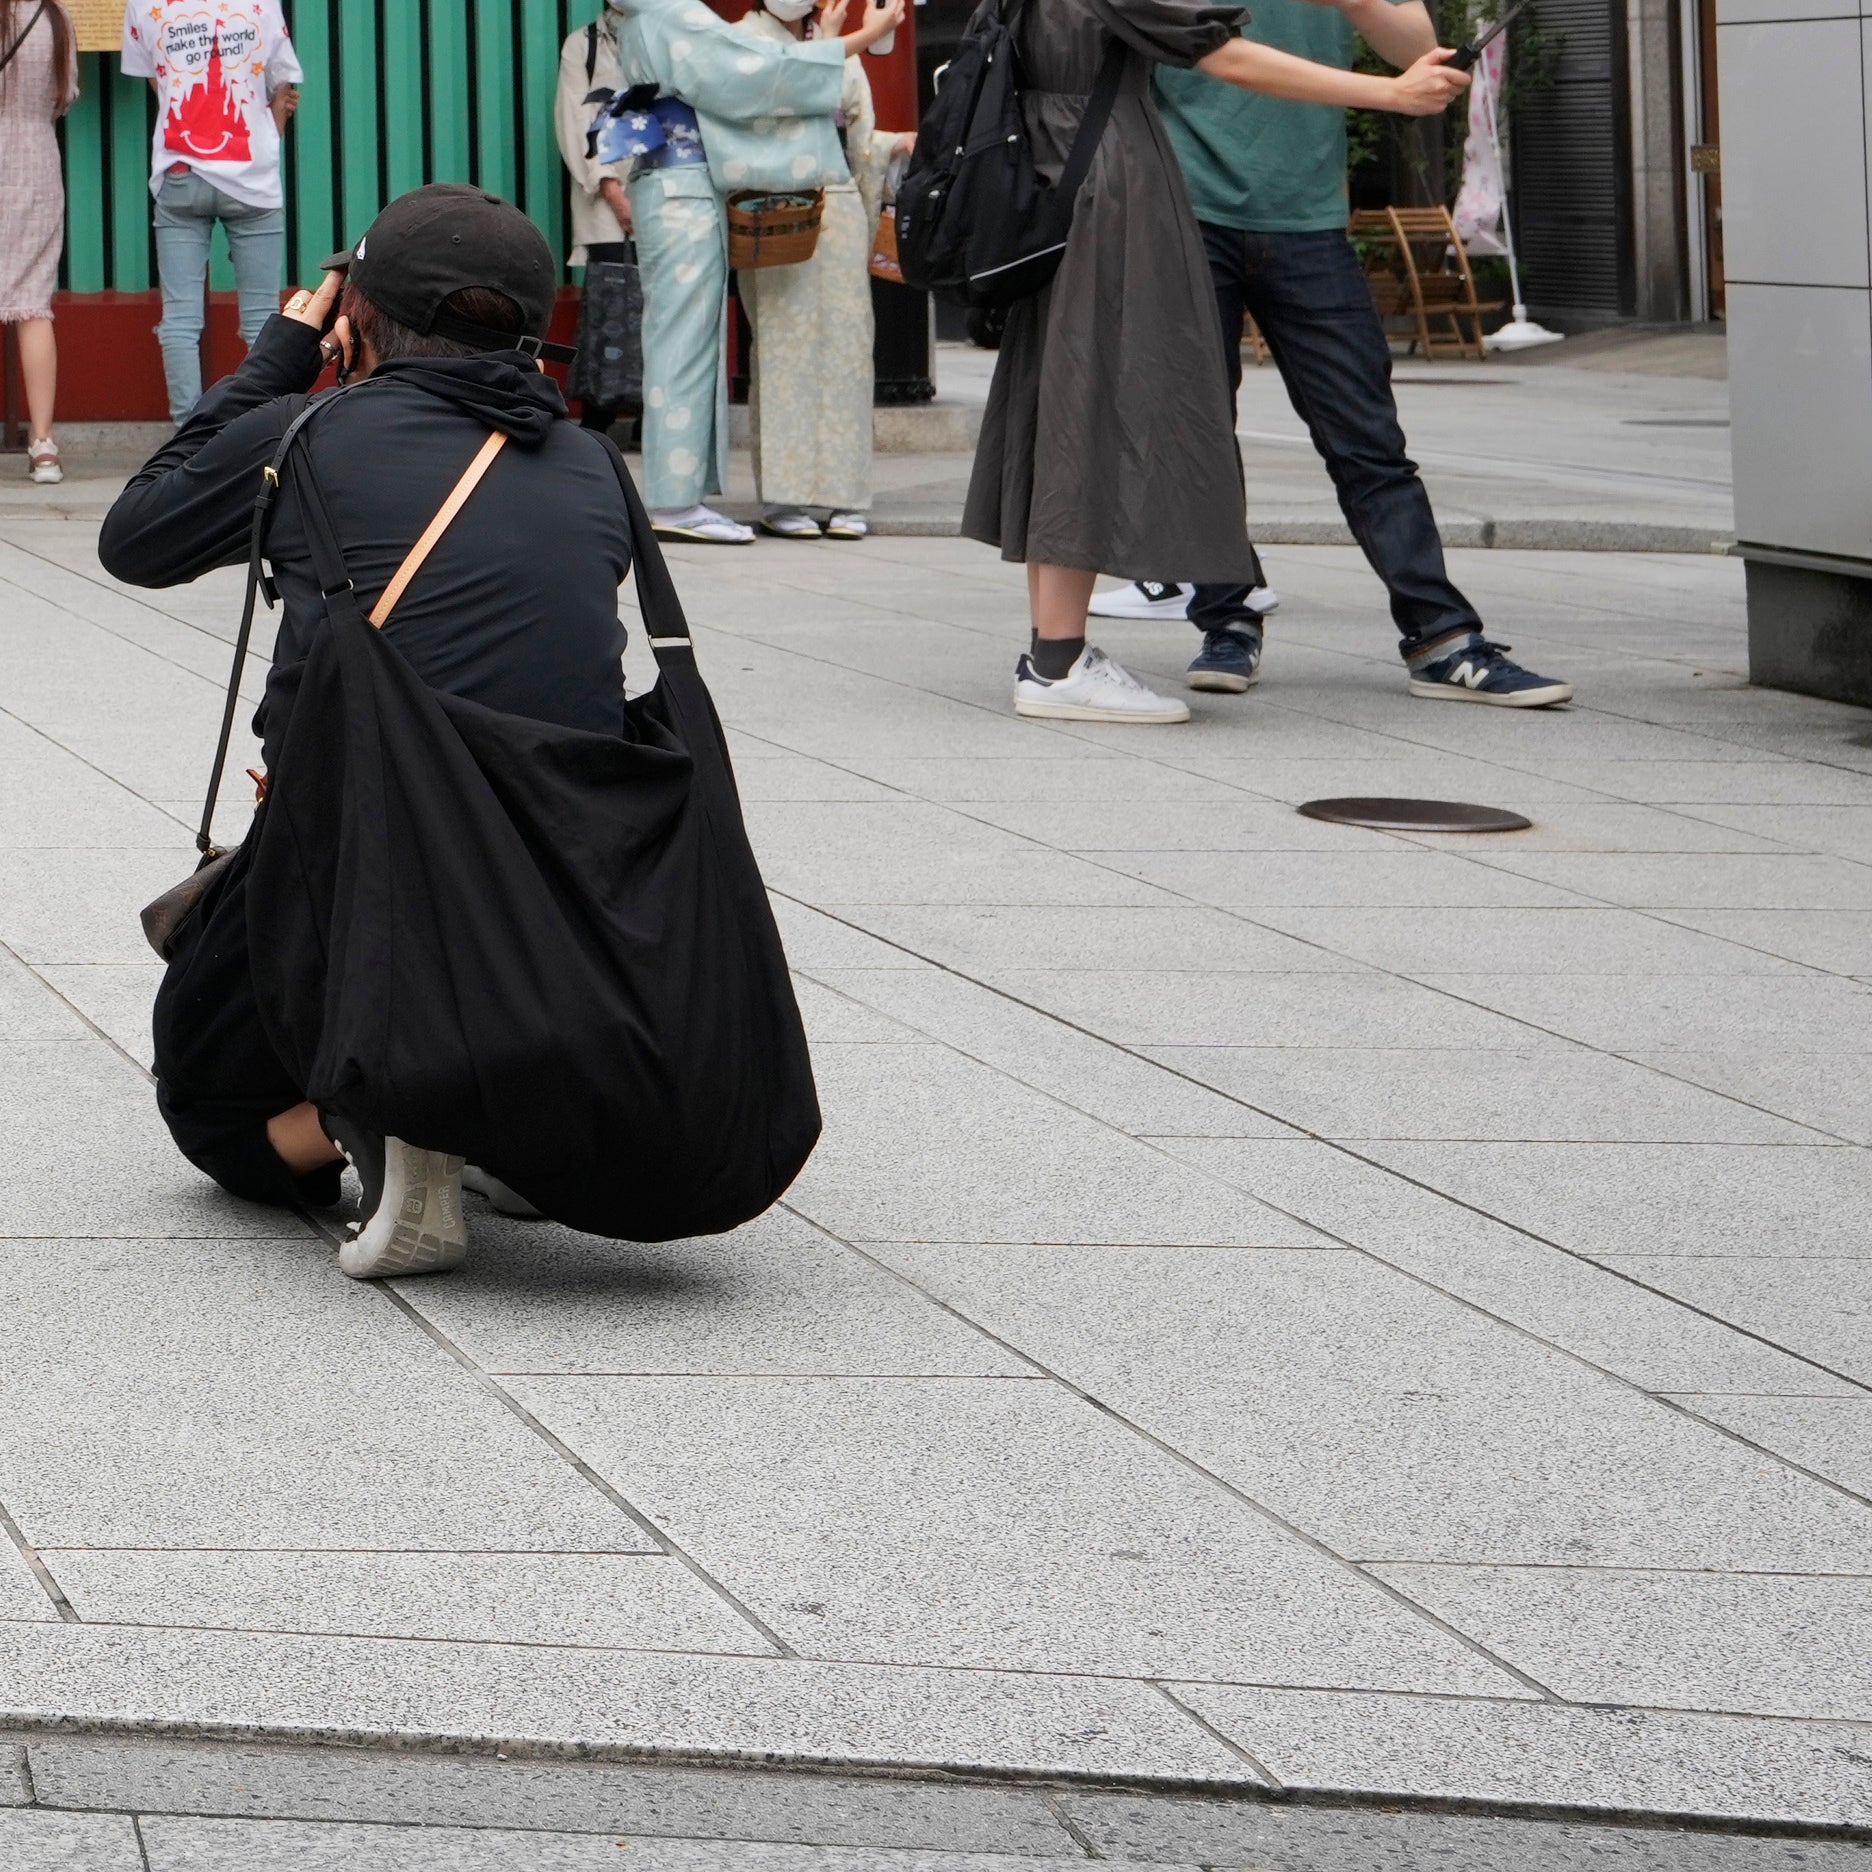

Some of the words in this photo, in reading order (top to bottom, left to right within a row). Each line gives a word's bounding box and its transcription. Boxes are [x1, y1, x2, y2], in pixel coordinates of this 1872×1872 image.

[168, 23, 208, 39] Smiles
[198, 35, 218, 47] the
[222, 29, 256, 43] world
[186, 51, 201, 66] go
[204, 43, 244, 60] round!
[1449, 660, 1490, 690] N
[438, 1184, 456, 1229] CAMPER
